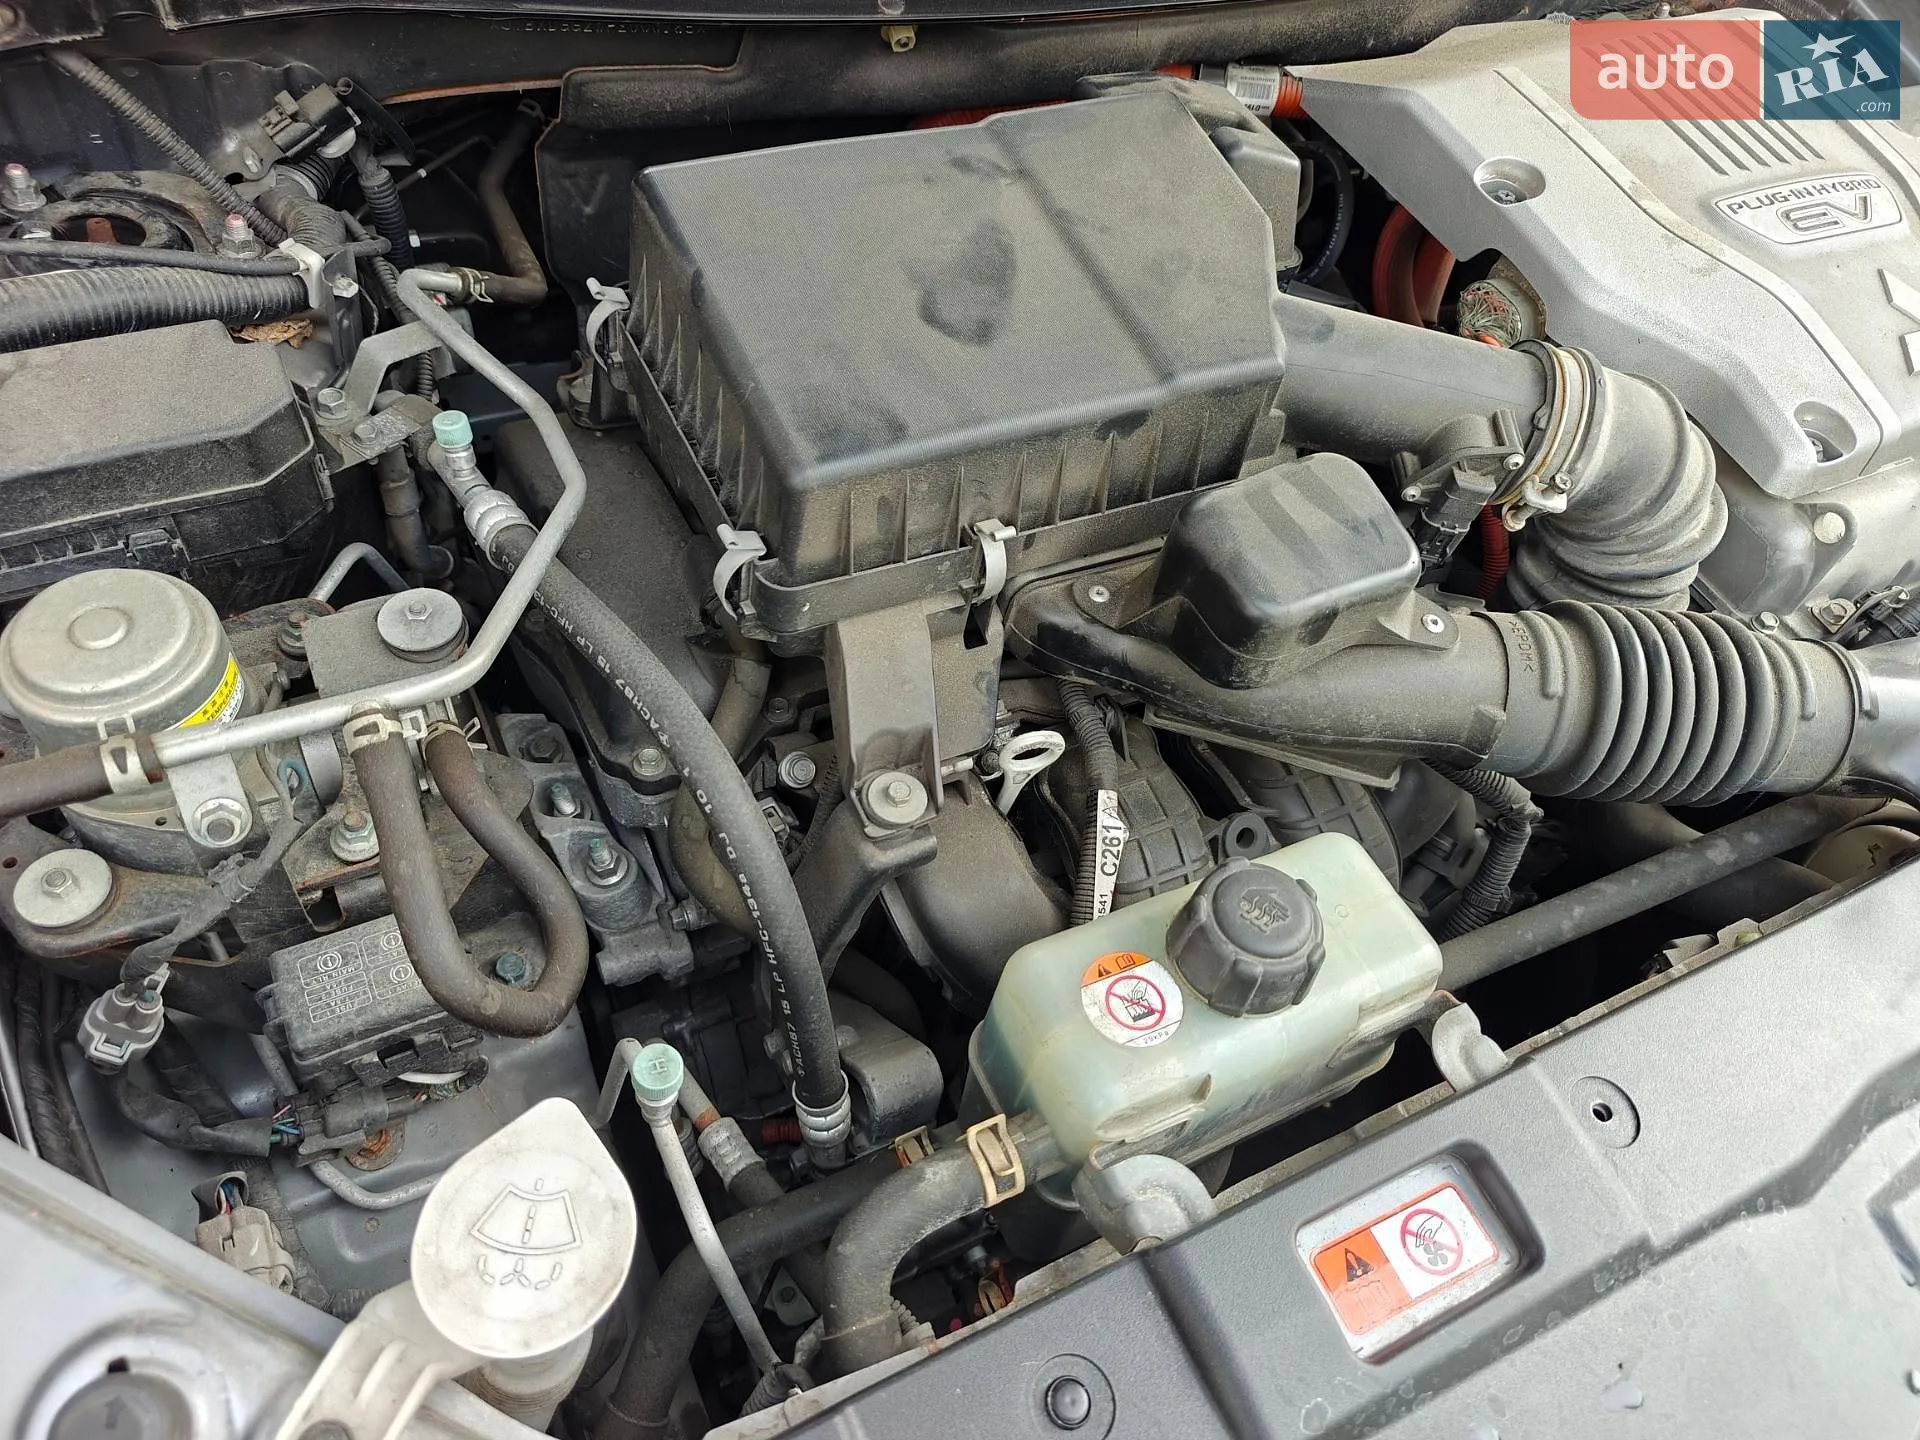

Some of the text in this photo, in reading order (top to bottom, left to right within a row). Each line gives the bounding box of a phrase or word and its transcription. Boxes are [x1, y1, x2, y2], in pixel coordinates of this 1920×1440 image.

[1726, 178, 1882, 214] PLUG-IN HYBRID
[1777, 193, 1871, 234] EV
[576, 635, 594, 655] LP
[718, 832, 737, 859] DJ
[1100, 825, 1122, 877] C261
[738, 873, 777, 965] HFC-134a
[772, 971, 786, 993] LP
